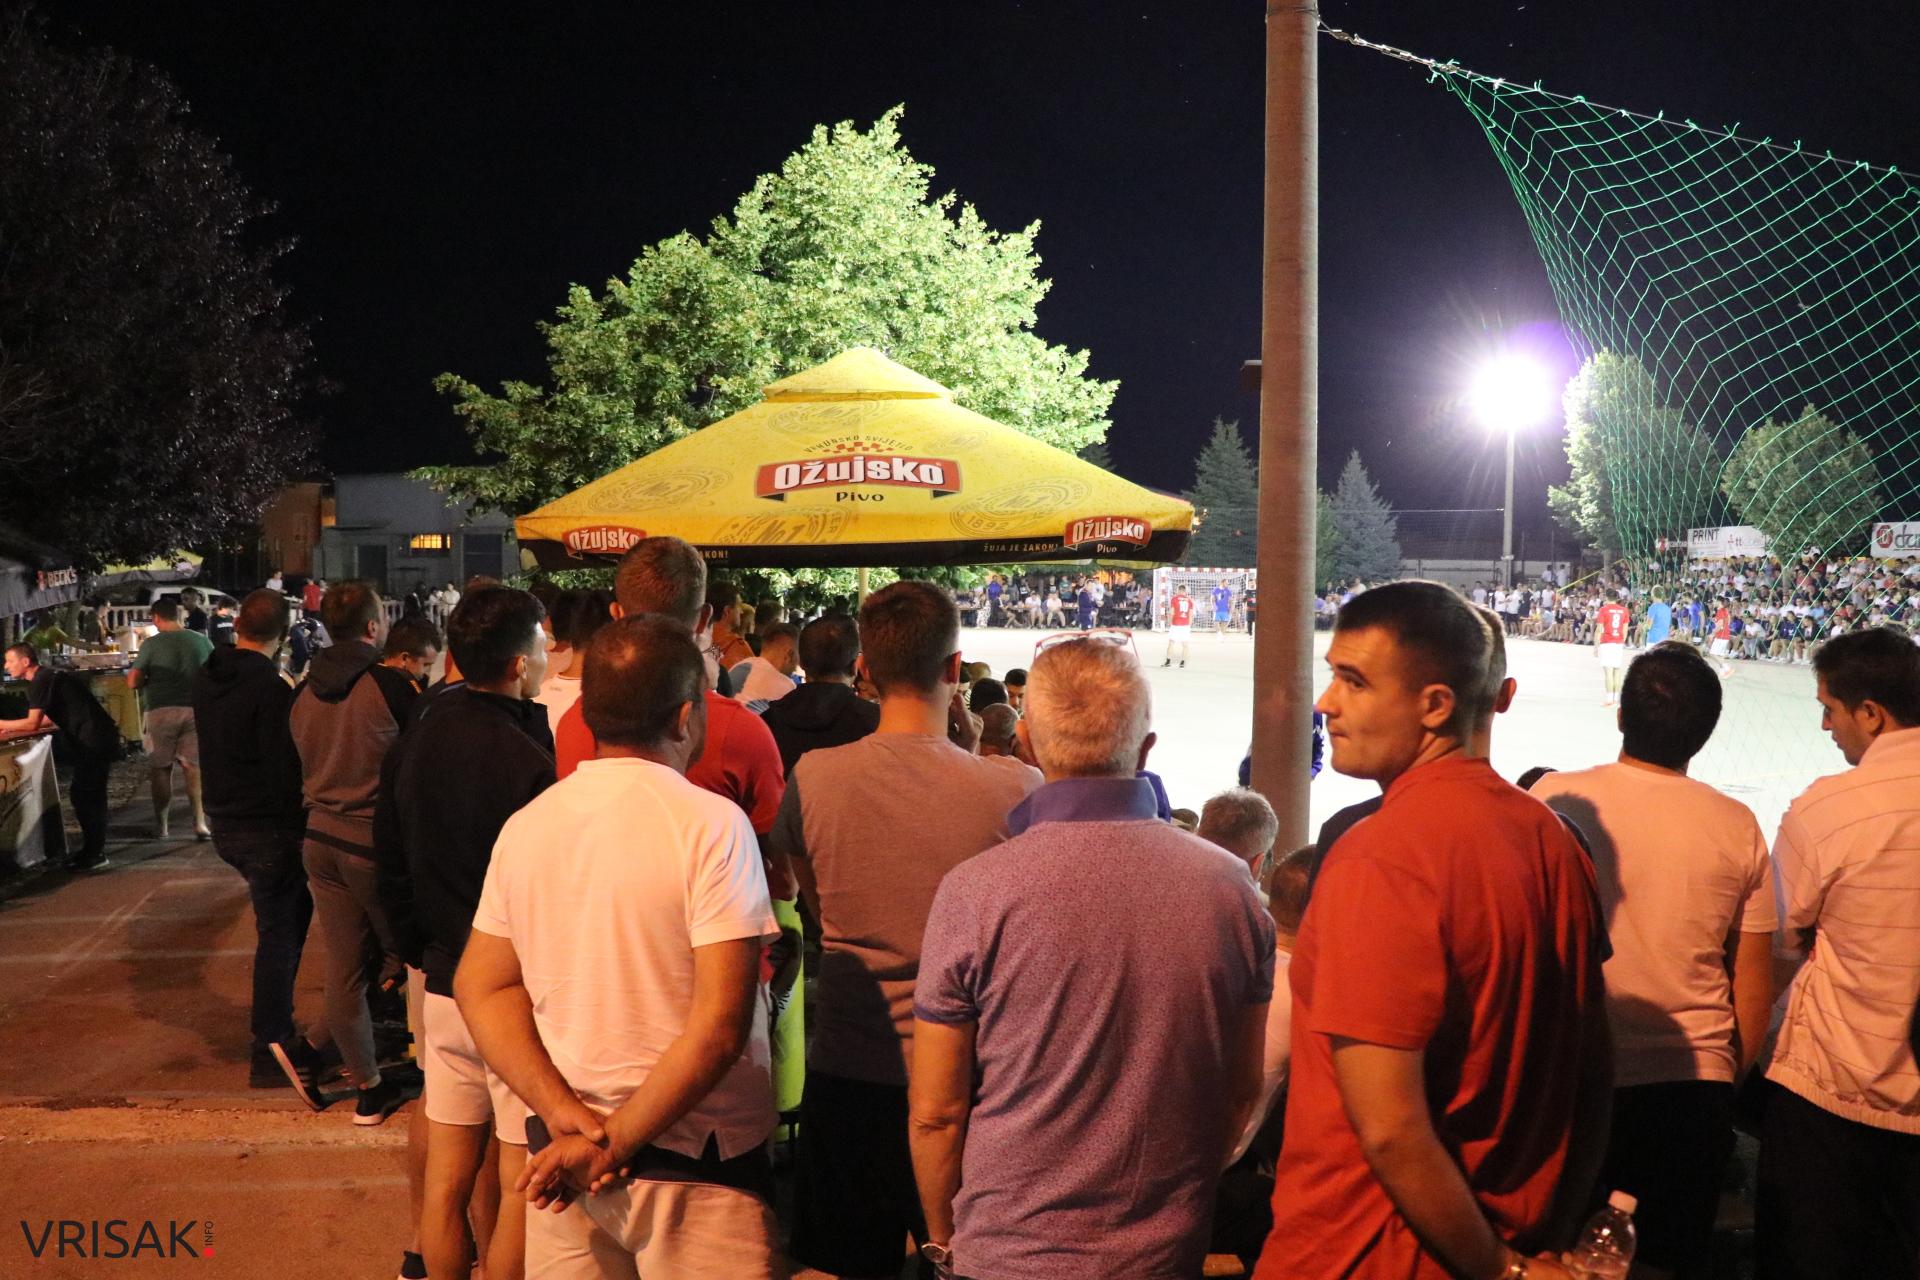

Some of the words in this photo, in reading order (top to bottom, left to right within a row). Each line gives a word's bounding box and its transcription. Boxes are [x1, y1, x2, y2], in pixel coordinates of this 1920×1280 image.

[774, 455, 945, 490] Ožujsko
[836, 491, 884, 502] Pivo
[1072, 517, 1145, 544] Ožujsko
[1693, 528, 1720, 543] PRINT
